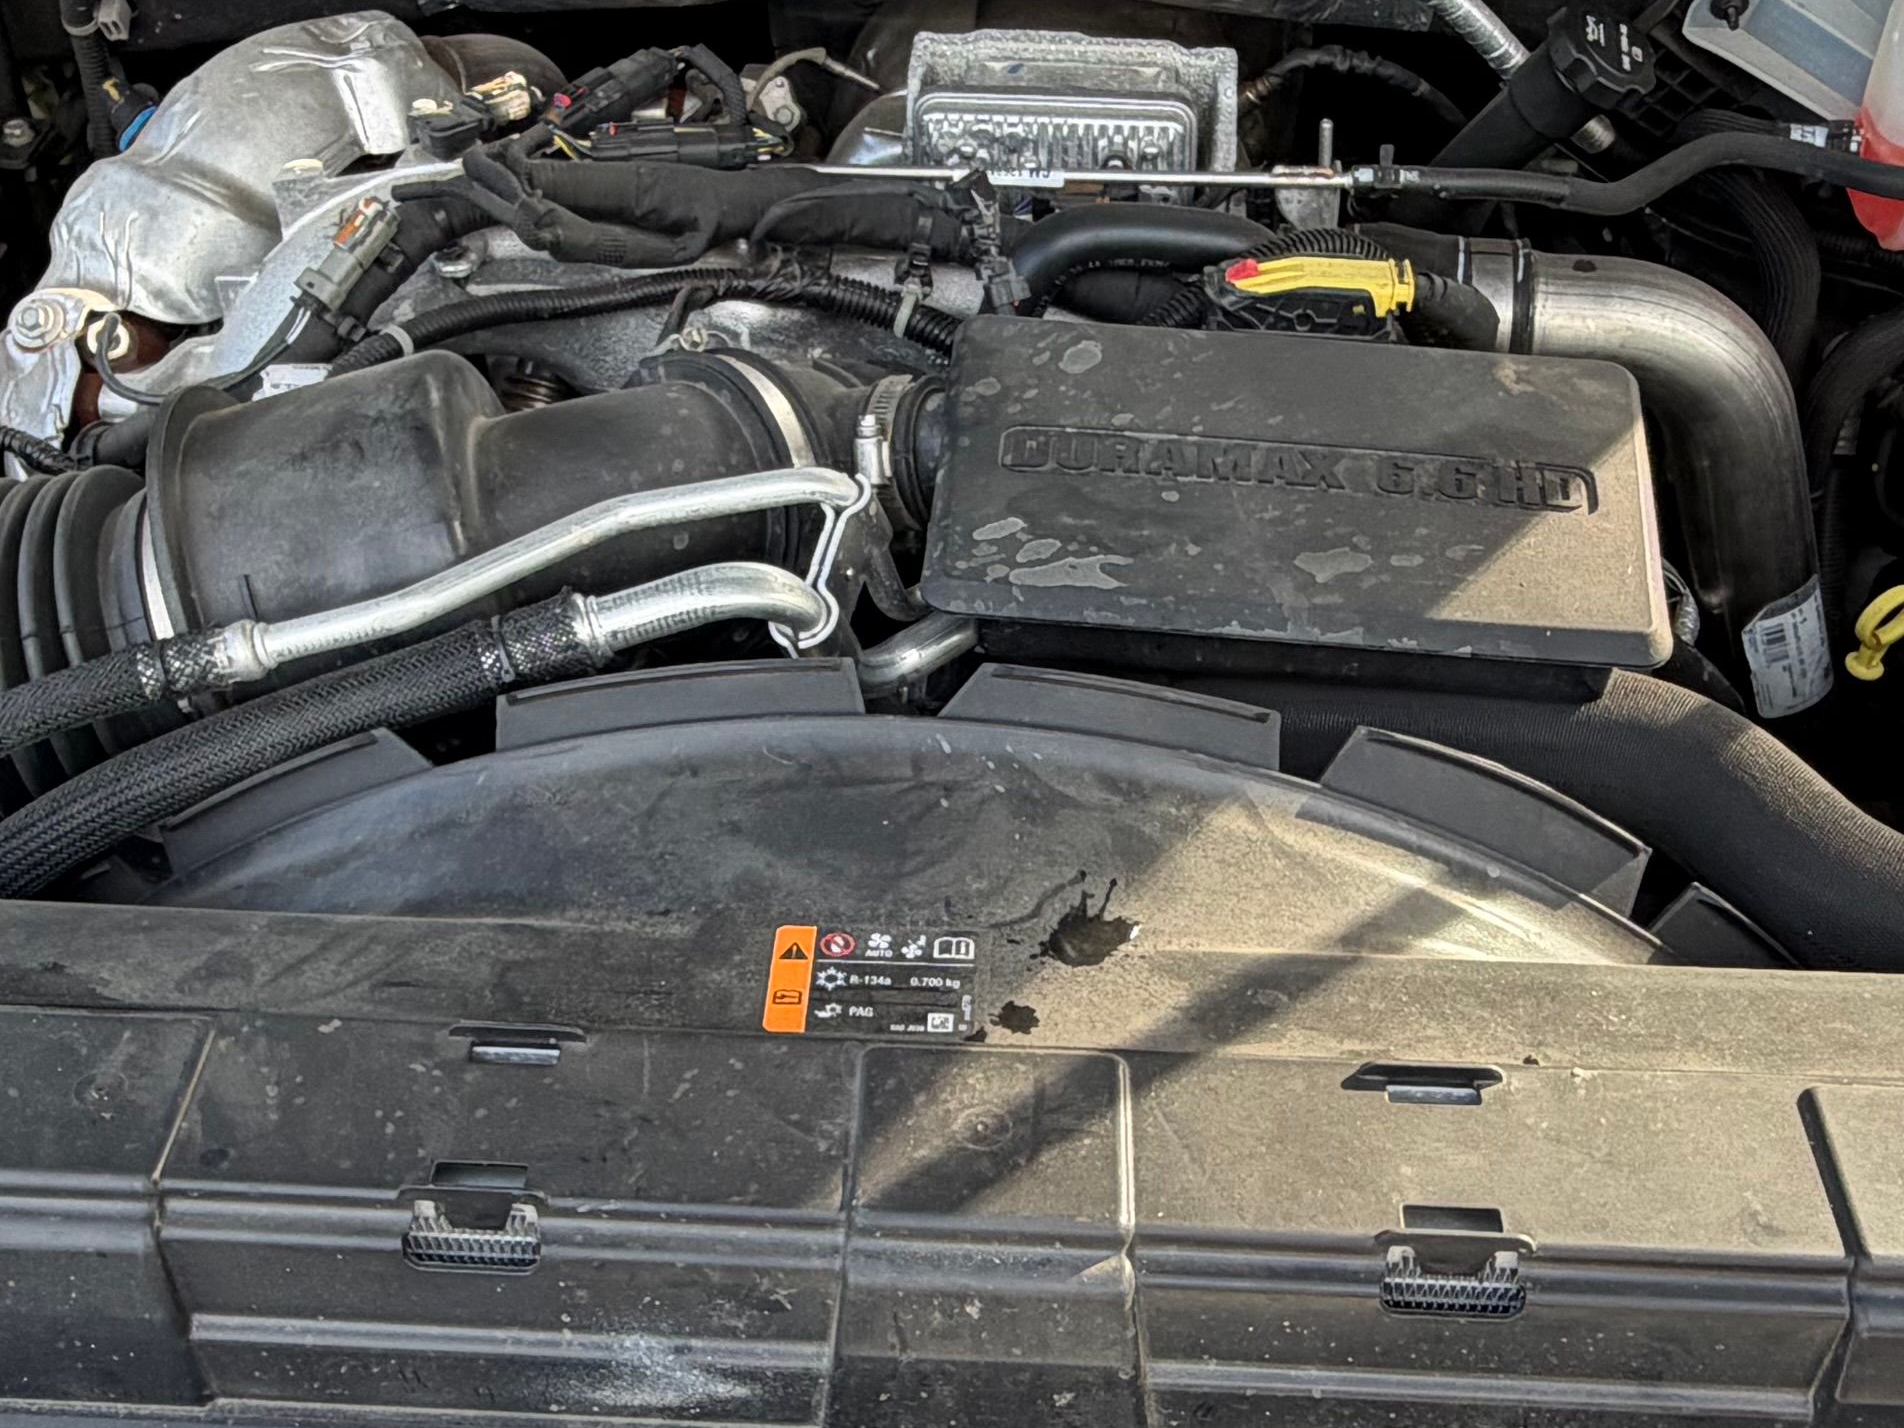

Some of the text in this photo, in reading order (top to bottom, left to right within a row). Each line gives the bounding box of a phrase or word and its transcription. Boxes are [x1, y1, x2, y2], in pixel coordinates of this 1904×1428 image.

[1002, 430, 1346, 490] DURAMAX
[1498, 461, 1584, 510] HD
[865, 949, 893, 958] AUTO
[849, 974, 961, 989] R-134a 0.700 kg
[848, 1006, 874, 1017] PAG
